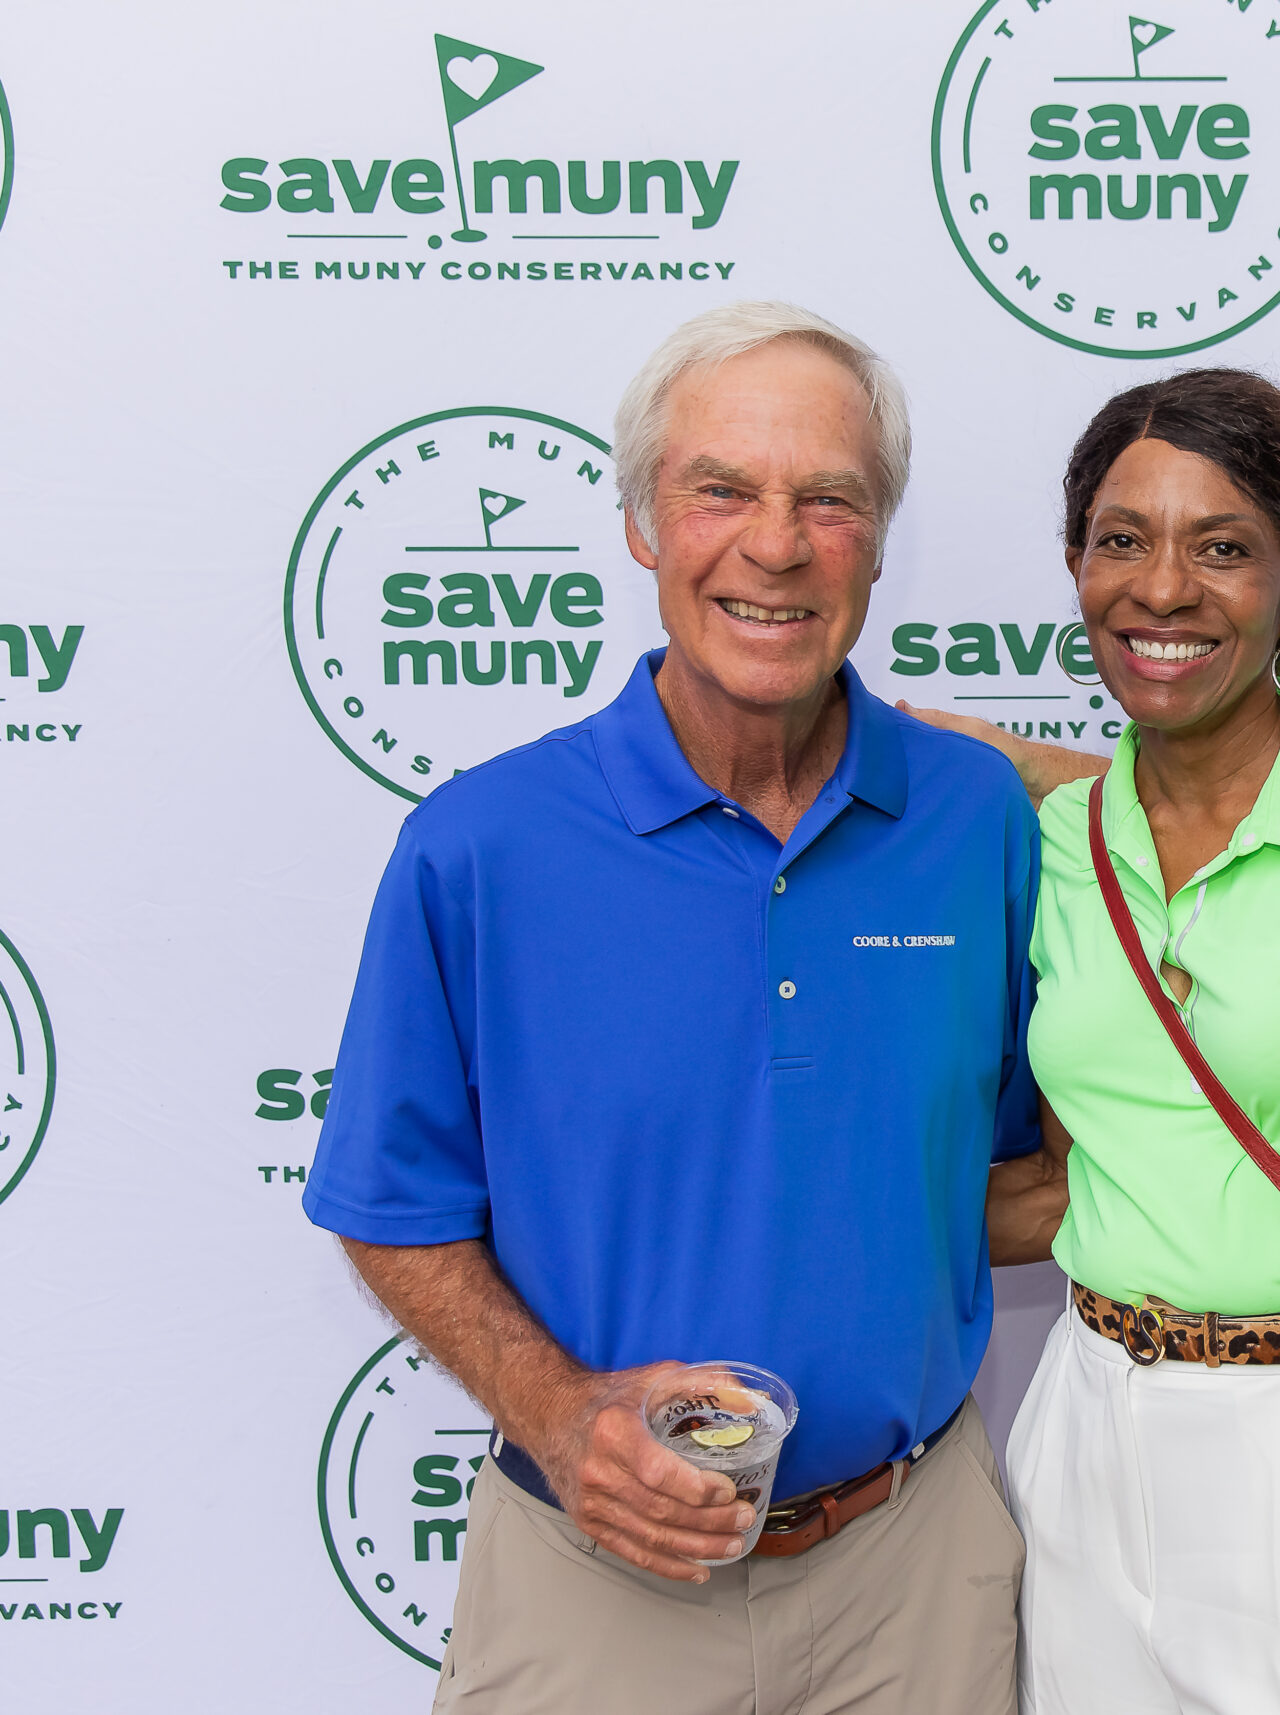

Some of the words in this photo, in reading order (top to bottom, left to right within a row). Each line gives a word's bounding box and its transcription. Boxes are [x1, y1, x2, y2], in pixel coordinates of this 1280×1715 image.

[1028, 103, 1250, 161] save
[219, 157, 445, 214] save
[473, 159, 740, 229] muny
[1029, 174, 1249, 233] muny
[222, 261, 299, 280] THE
[315, 261, 425, 280] MUNY
[440, 261, 735, 281] CONSERVANCY
[344, 440, 440, 510] THE
[488, 431, 612, 496] MUN
[380, 572, 604, 628] save
[382, 639, 604, 698] muny
[889, 621, 1100, 677] save
[852, 936, 891, 947] COORE
[892, 935, 903, 947] &
[903, 935, 956, 947] CRENSHAW
